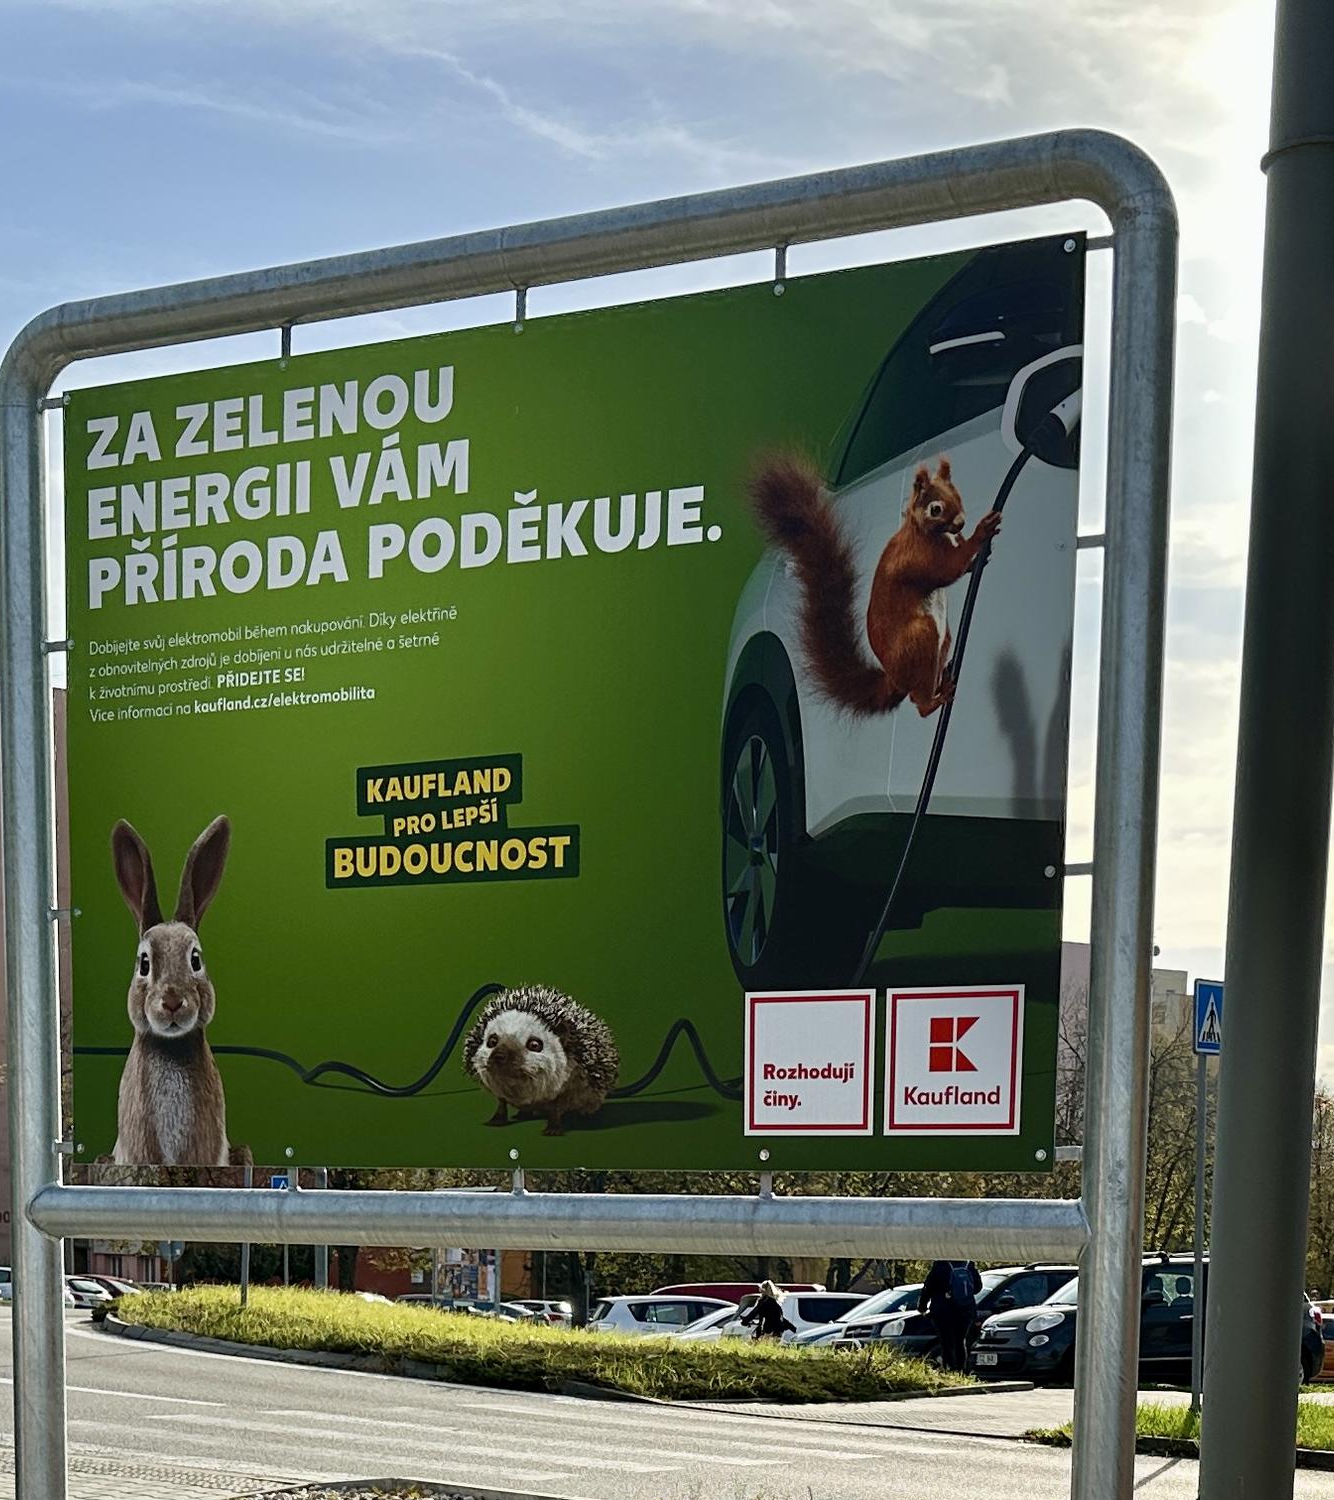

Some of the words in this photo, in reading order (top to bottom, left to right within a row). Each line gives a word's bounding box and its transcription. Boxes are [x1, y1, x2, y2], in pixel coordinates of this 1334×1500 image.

[86, 411, 161, 471] ZA
[174, 365, 456, 458] ZELENOU
[88, 460, 312, 541] ENERGII
[328, 431, 470, 510] VÁM
[88, 528, 350, 610] PŘÍRODA
[367, 484, 723, 580] PODĚKUJE.
[89, 637, 141, 657] Dobíjejte
[143, 633, 166, 652] svůj
[168, 625, 243, 649] elektromobil
[244, 623, 288, 640] během
[368, 611, 397, 630] Díky
[89, 667, 96, 679] z
[98, 656, 178, 676] obnovitelných
[180, 652, 218, 670] zdrojů
[219, 651, 231, 668] je
[233, 646, 281, 666] dobíjení
[284, 648, 292, 659] u
[295, 643, 318, 659] nás
[320, 637, 384, 657] udržitelné
[386, 639, 395, 650] a
[398, 631, 440, 649] šetrné
[89, 686, 96, 701] k
[99, 680, 156, 700] životnímu
[217, 668, 281, 689] PŘIDEJTE
[284, 666, 306, 682] SE!
[89, 707, 115, 723] Více
[117, 702, 173, 721] informací
[176, 704, 191, 716] na
[194, 686, 376, 715] kaufland.cz/elektromobilita
[366, 767, 512, 804] KAUFLAND
[393, 815, 436, 837] PRO
[441, 797, 499, 830] LEPŠÍ
[333, 835, 571, 879] BUDOUCNOST
[763, 1061, 855, 1084] Rozhodují
[763, 1087, 802, 1110] činy.
[903, 1085, 1001, 1106] Kaufland
